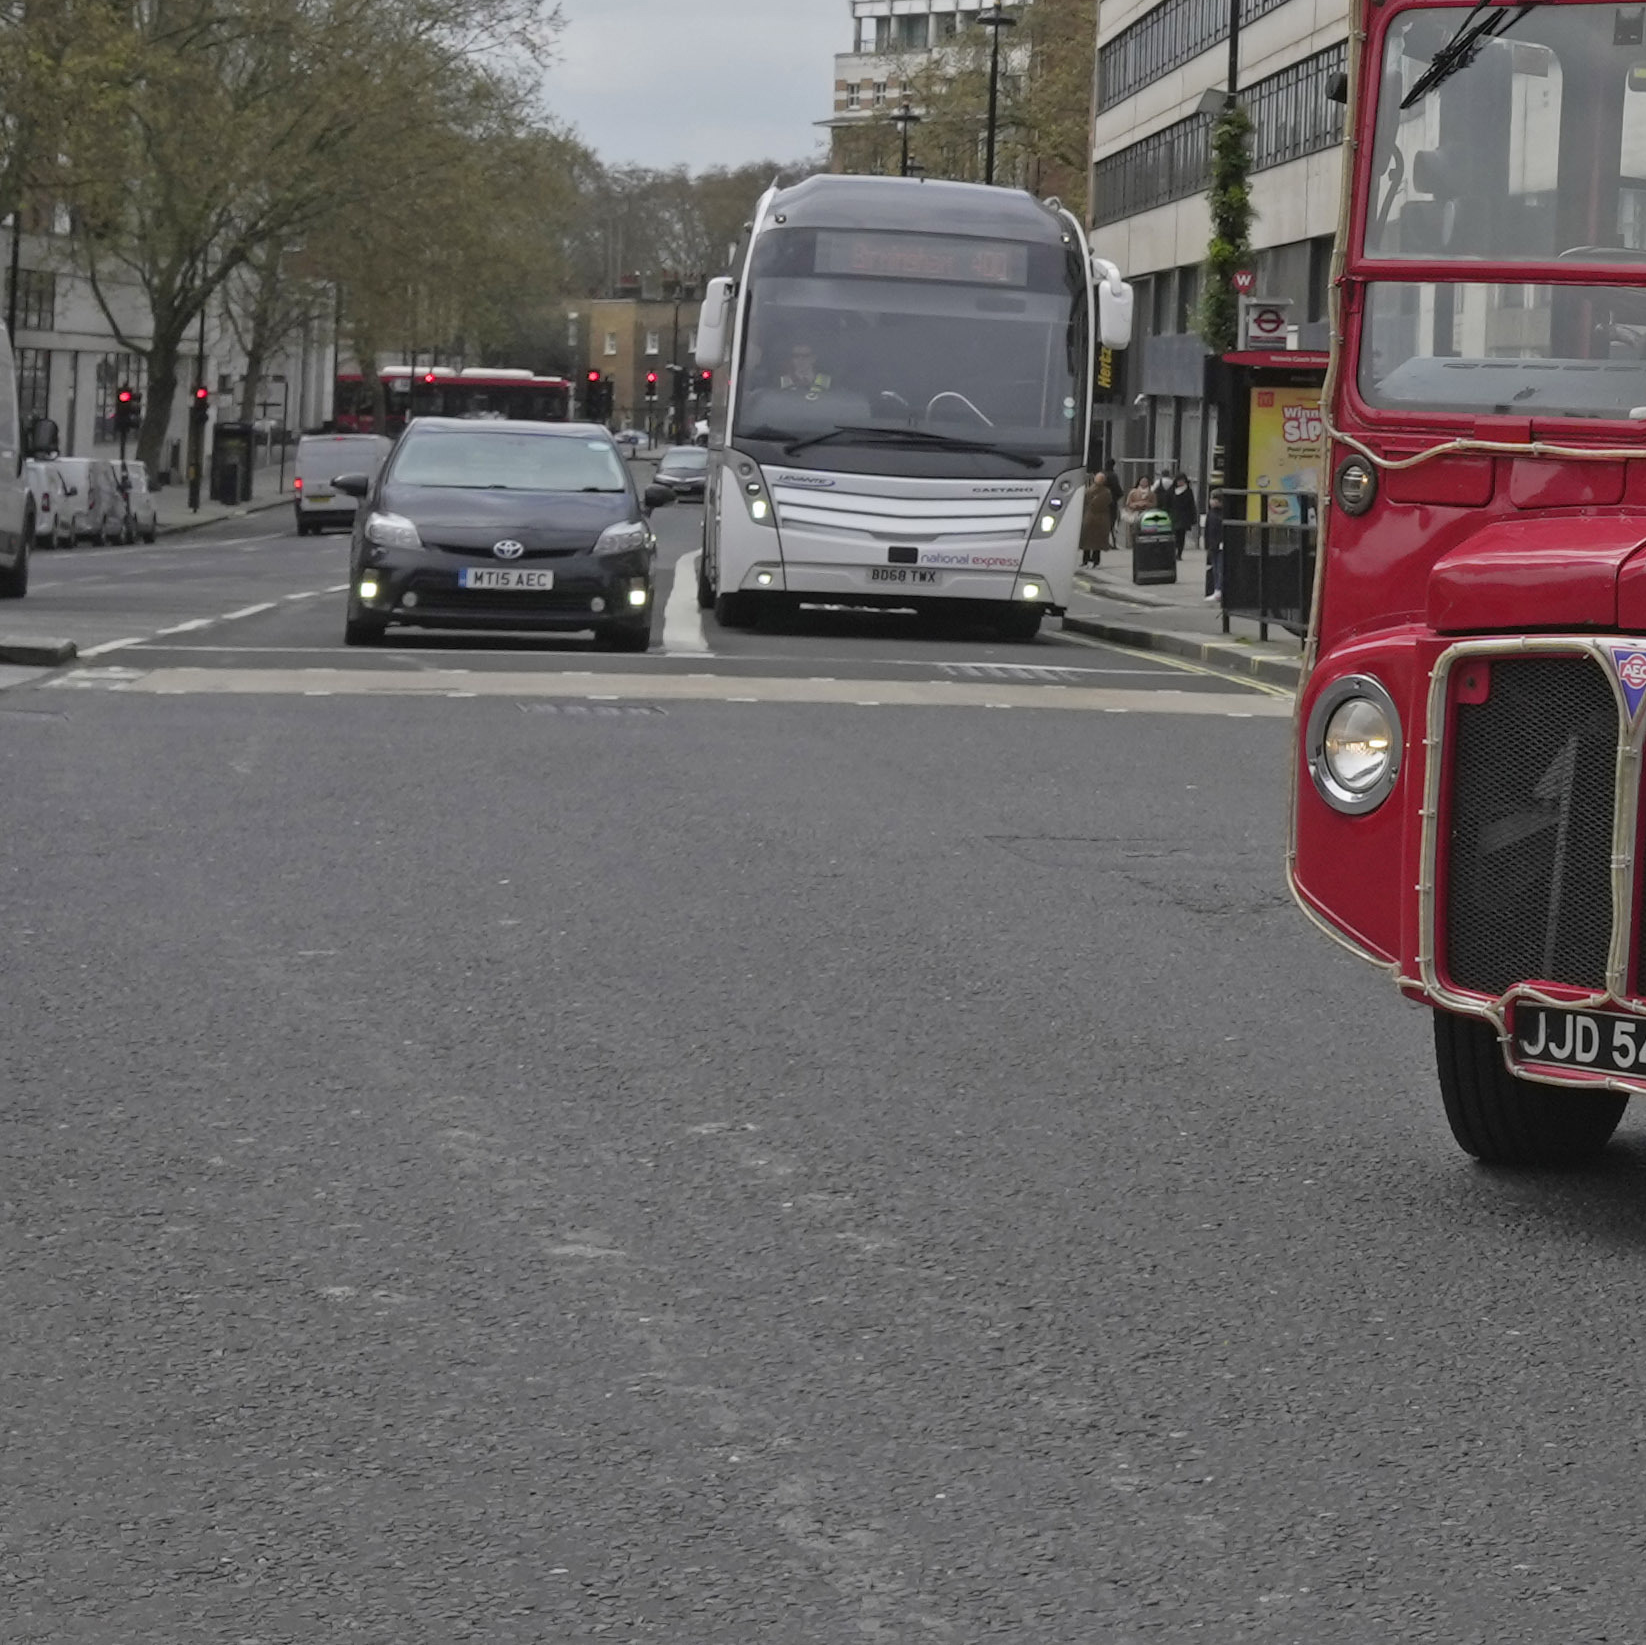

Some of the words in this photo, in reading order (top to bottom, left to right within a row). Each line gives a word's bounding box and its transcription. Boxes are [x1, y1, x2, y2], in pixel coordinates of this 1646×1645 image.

[1236, 274, 1252, 287] W
[1283, 405, 1321, 420] Winn
[920, 553, 969, 565] national
[972, 555, 1020, 568] express
[474, 571, 510, 586] MT15
[515, 573, 547, 587] AEC
[910, 570, 936, 583] TWX
[1519, 1011, 1600, 1063] JJD
